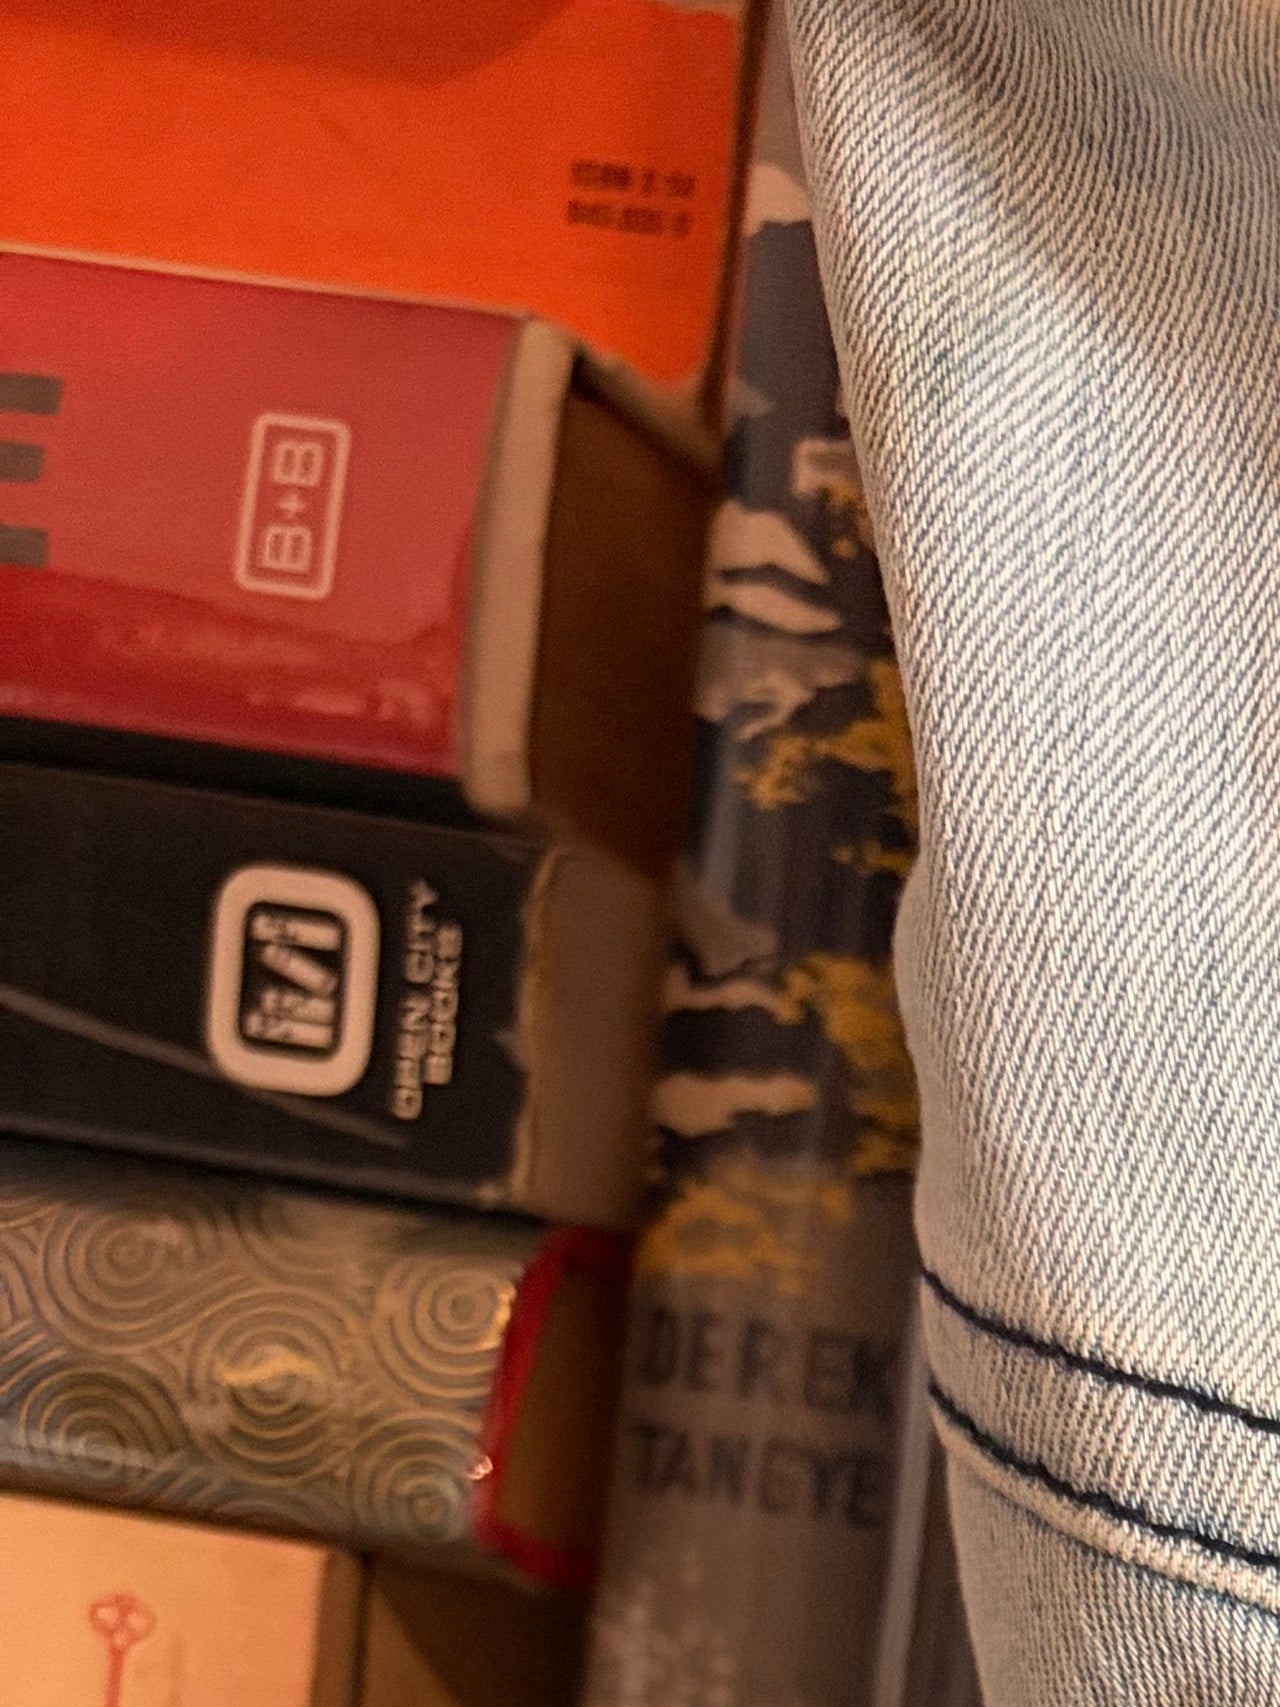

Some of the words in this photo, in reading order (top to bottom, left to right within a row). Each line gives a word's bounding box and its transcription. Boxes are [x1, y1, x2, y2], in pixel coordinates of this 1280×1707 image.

[403, 879, 438, 984] CITY
[392, 990, 434, 1120] OPEN
[423, 925, 463, 1085] BOOKS
[637, 1304, 900, 1420] DEREK
